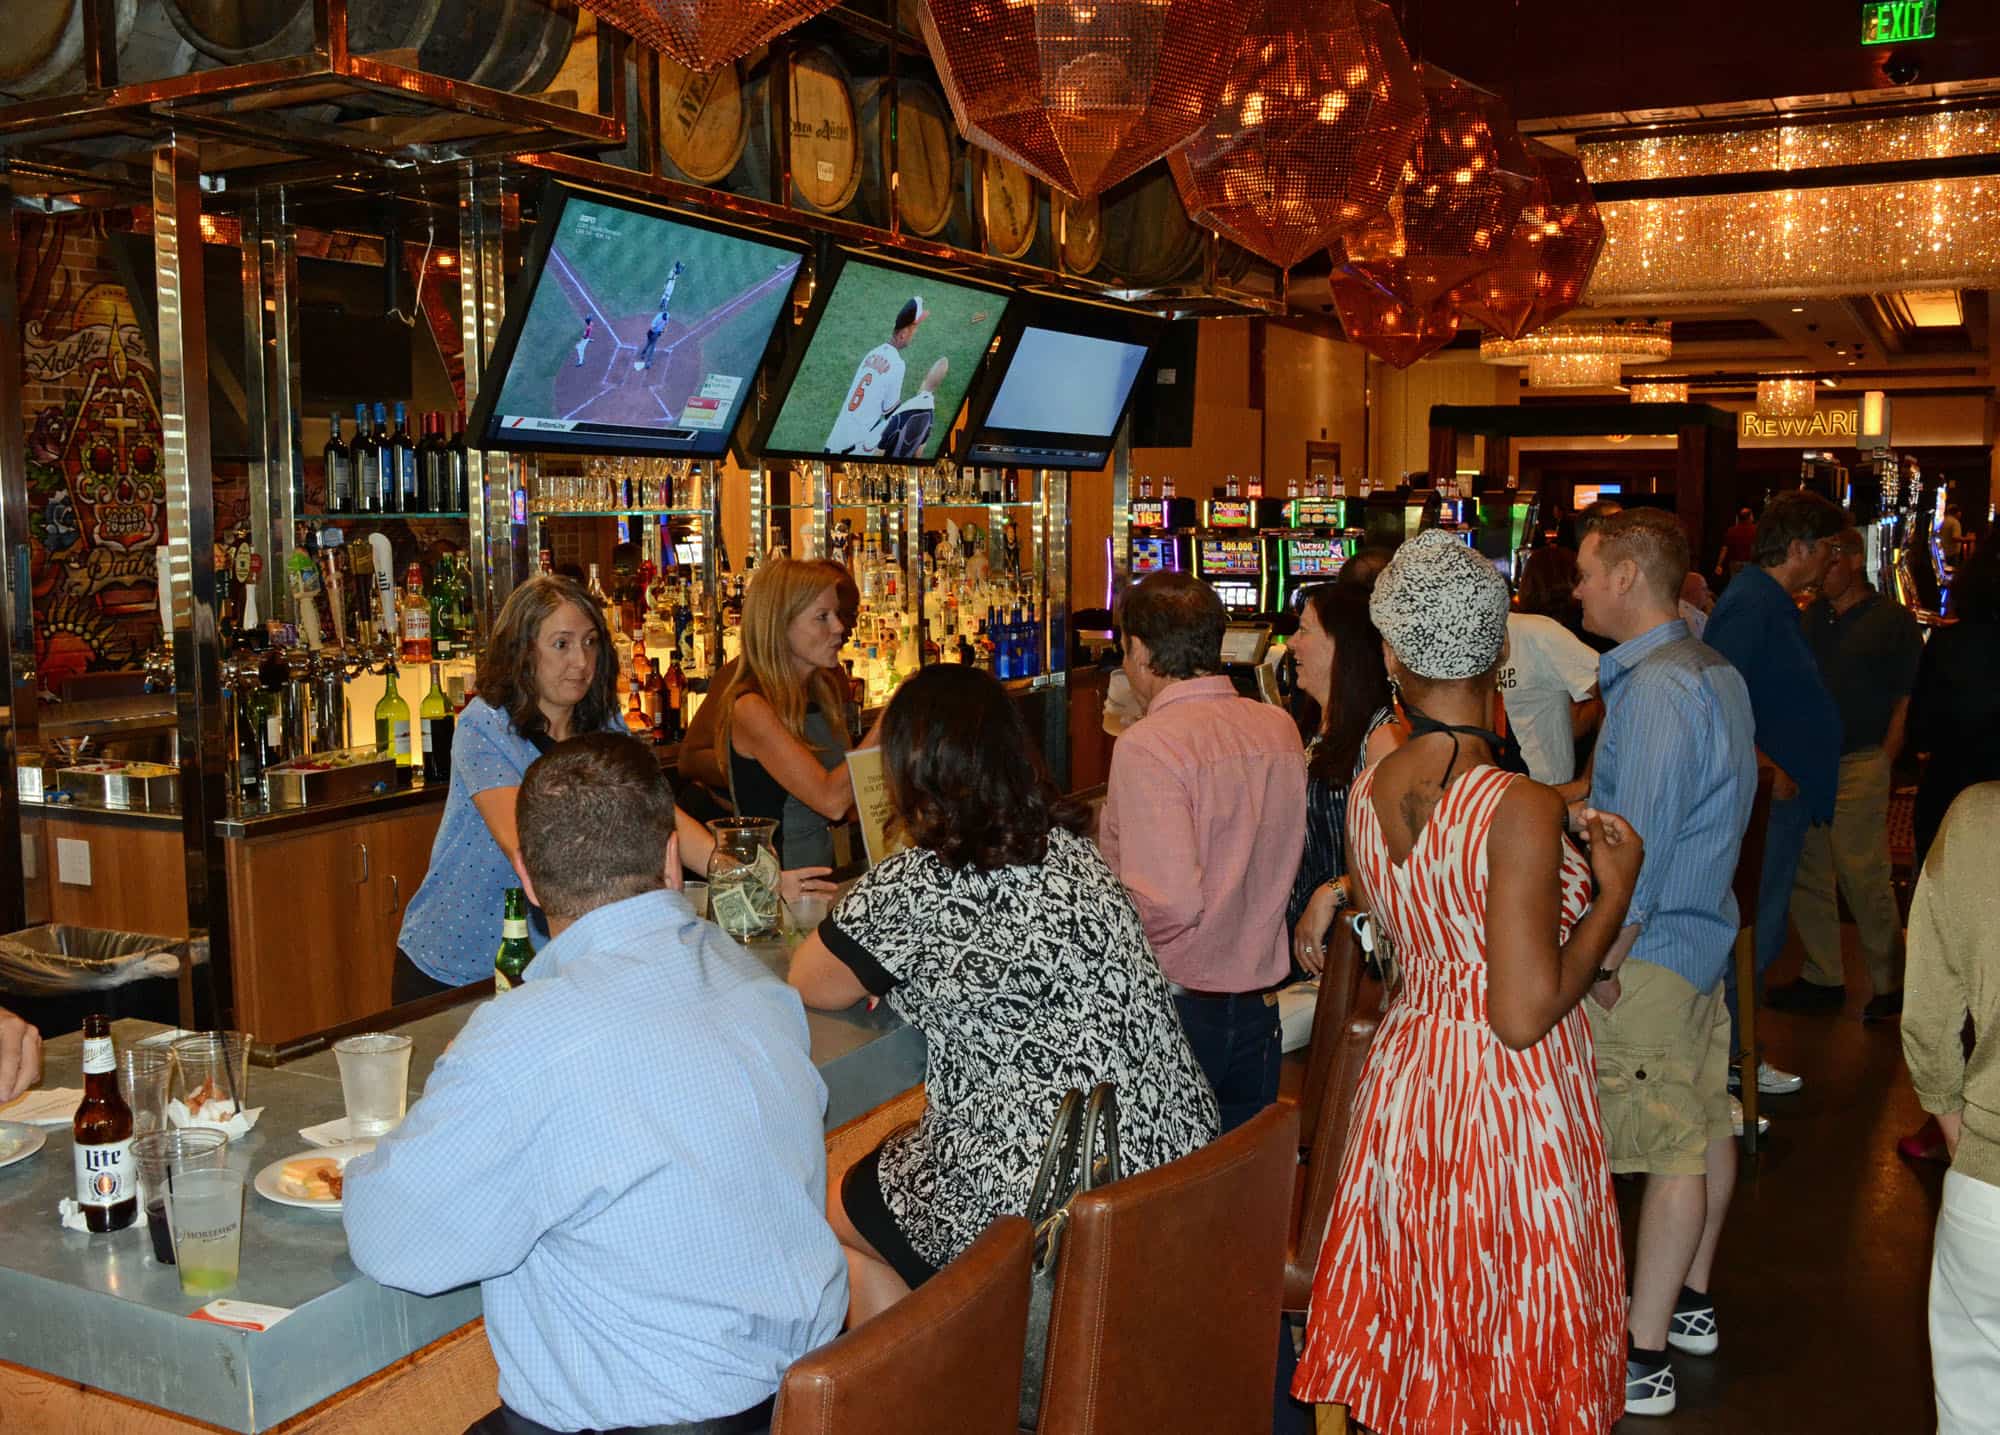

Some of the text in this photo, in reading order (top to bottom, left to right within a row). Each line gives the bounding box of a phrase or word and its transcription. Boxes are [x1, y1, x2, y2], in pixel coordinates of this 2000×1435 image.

[1877, 1, 1924, 40] EXIT
[848, 373, 872, 412] 6
[85, 1149, 121, 1172] Lite
